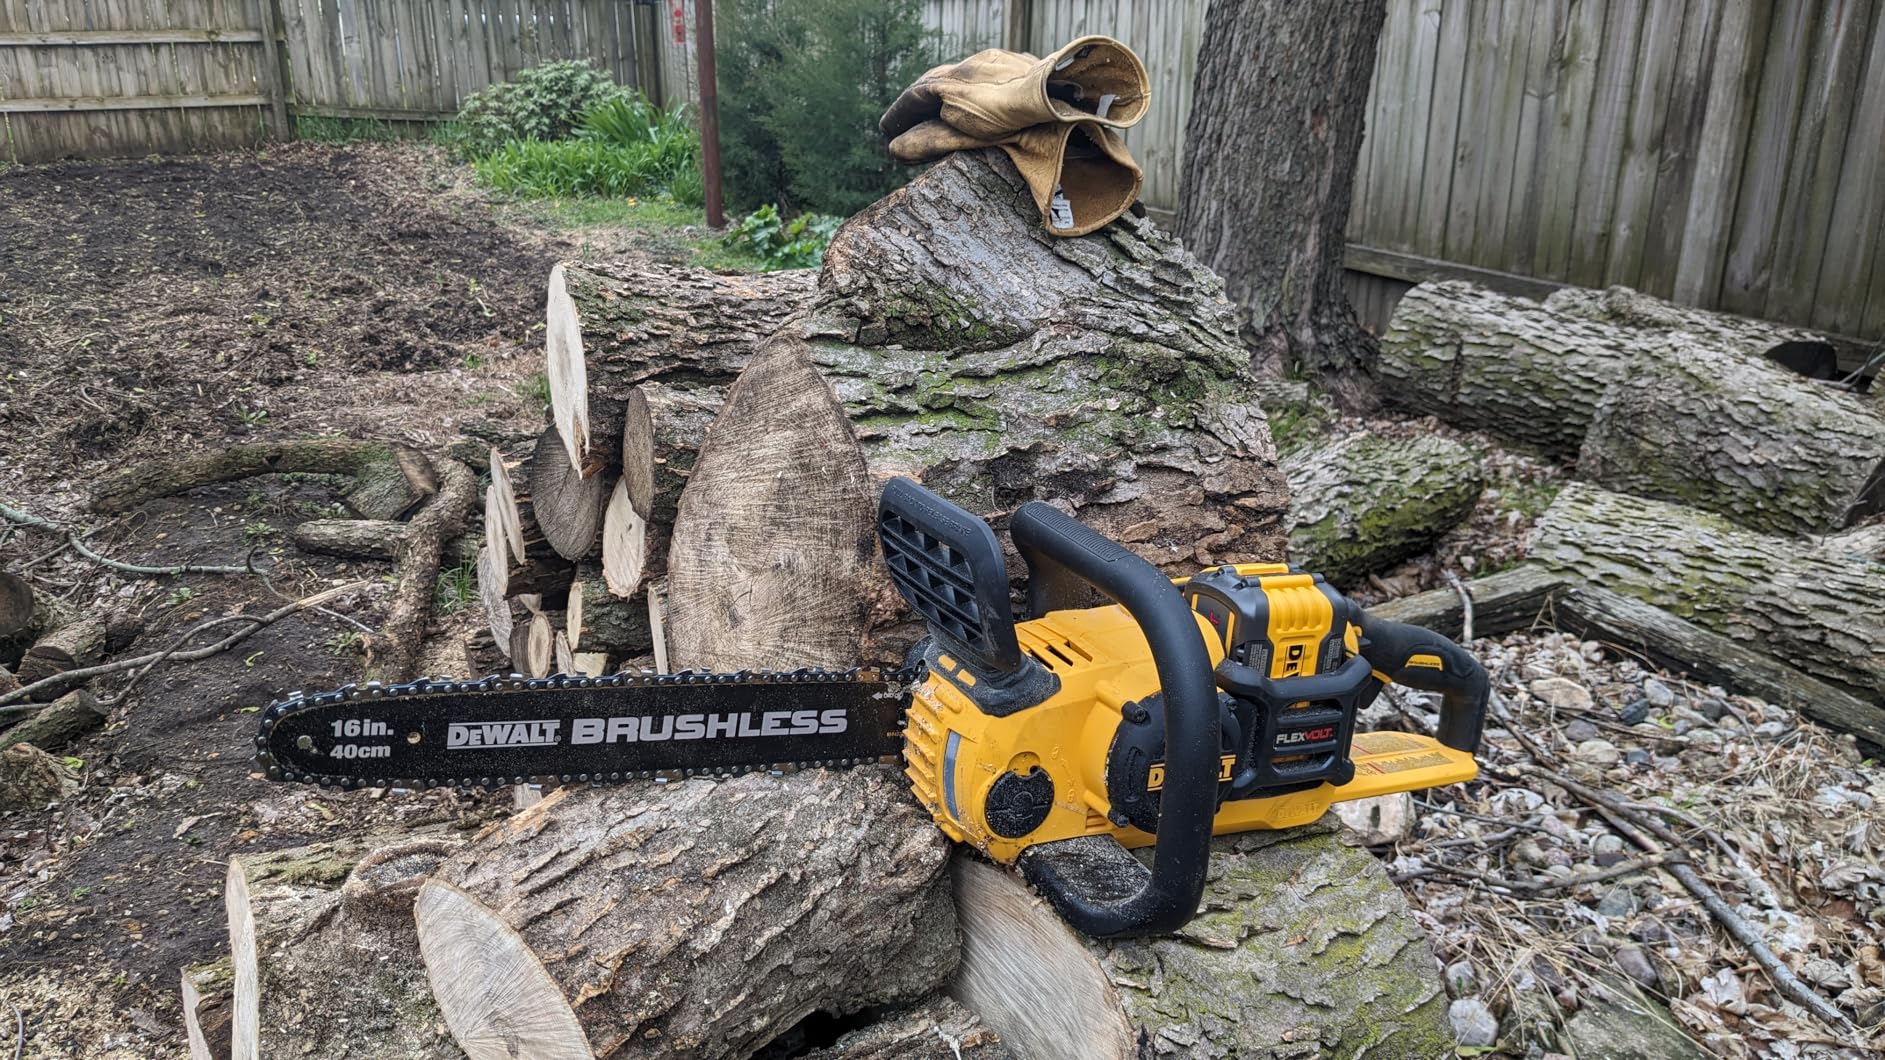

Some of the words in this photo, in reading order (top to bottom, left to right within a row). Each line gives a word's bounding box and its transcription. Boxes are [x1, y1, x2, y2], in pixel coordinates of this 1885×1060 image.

[571, 709, 848, 745] BRUSHLESS
[1275, 727, 1333, 745] FLEXVOLT
[329, 744, 391, 759] 40cm
